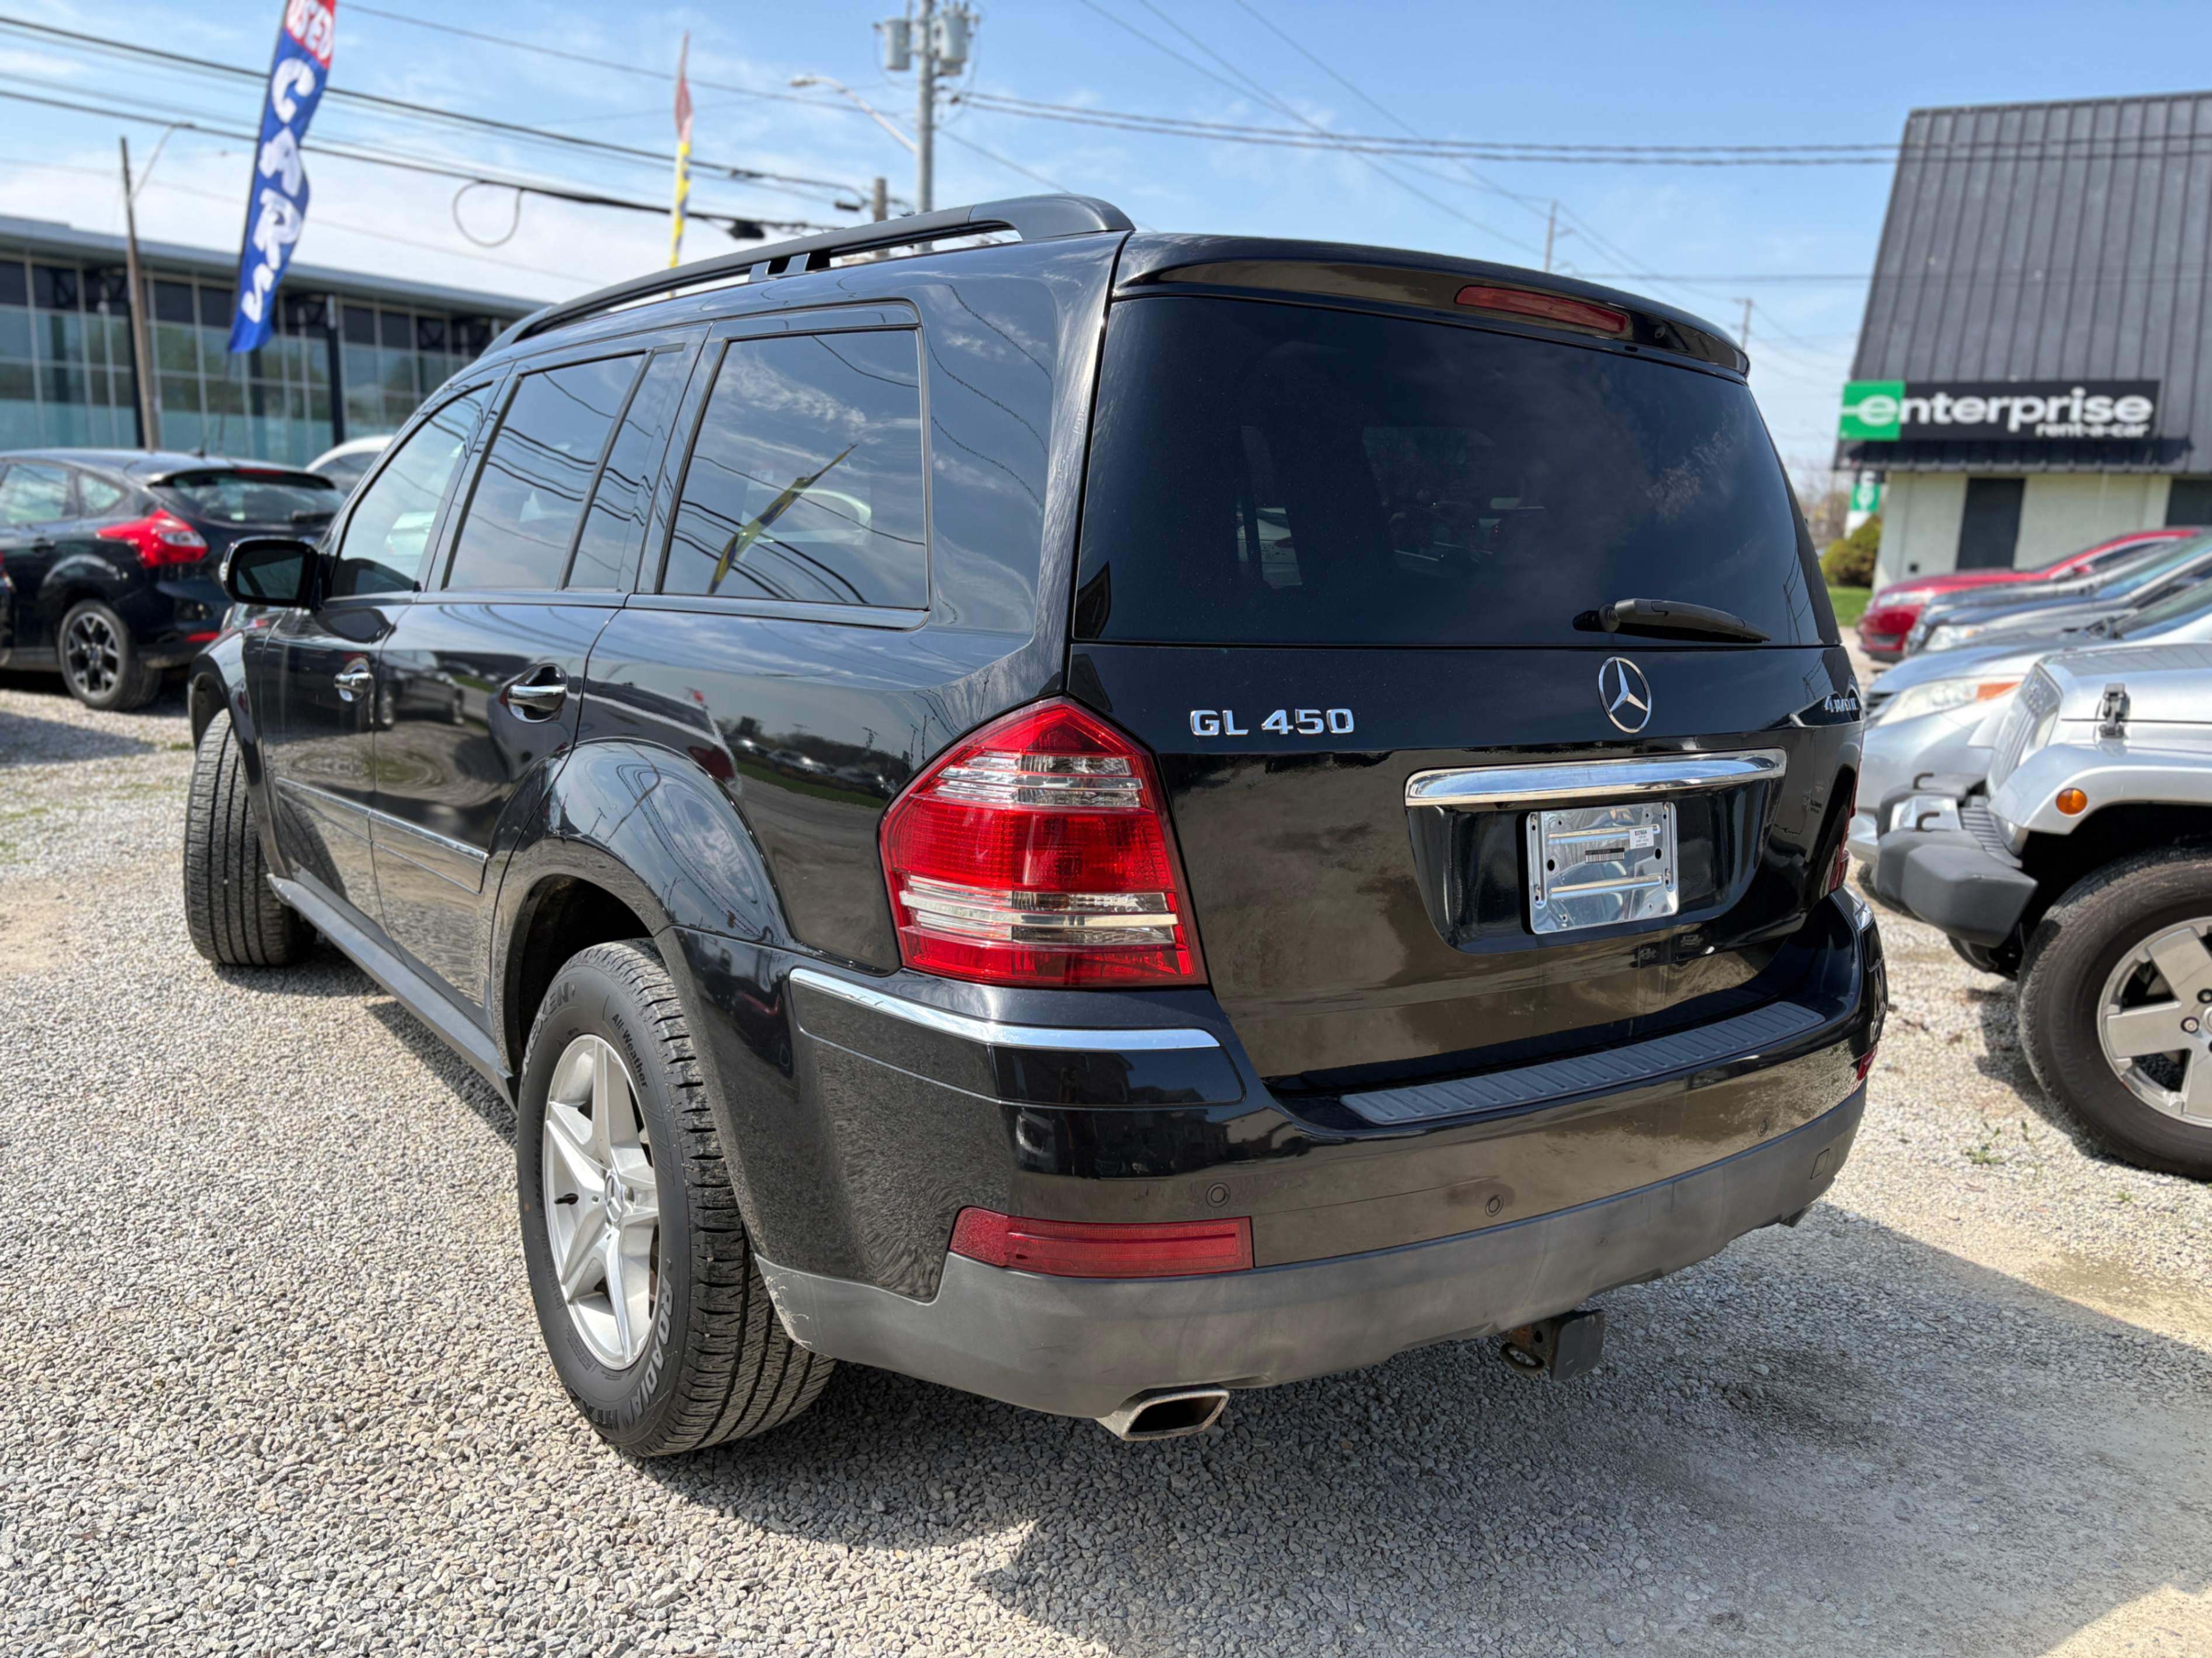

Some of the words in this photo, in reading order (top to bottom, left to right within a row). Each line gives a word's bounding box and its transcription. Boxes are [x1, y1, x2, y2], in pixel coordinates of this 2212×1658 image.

[287, 0, 332, 59] USED
[241, 57, 315, 323] CARS
[1841, 387, 2154, 431] enterprise
[2035, 422, 2150, 437] rent-a-car
[1190, 709, 1249, 736] GL
[1260, 708, 1355, 735] 450
[522, 981, 570, 1077] NEXEN
[612, 1013, 648, 1089] All-Weather
[621, 1275, 673, 1428] ROADIAN
